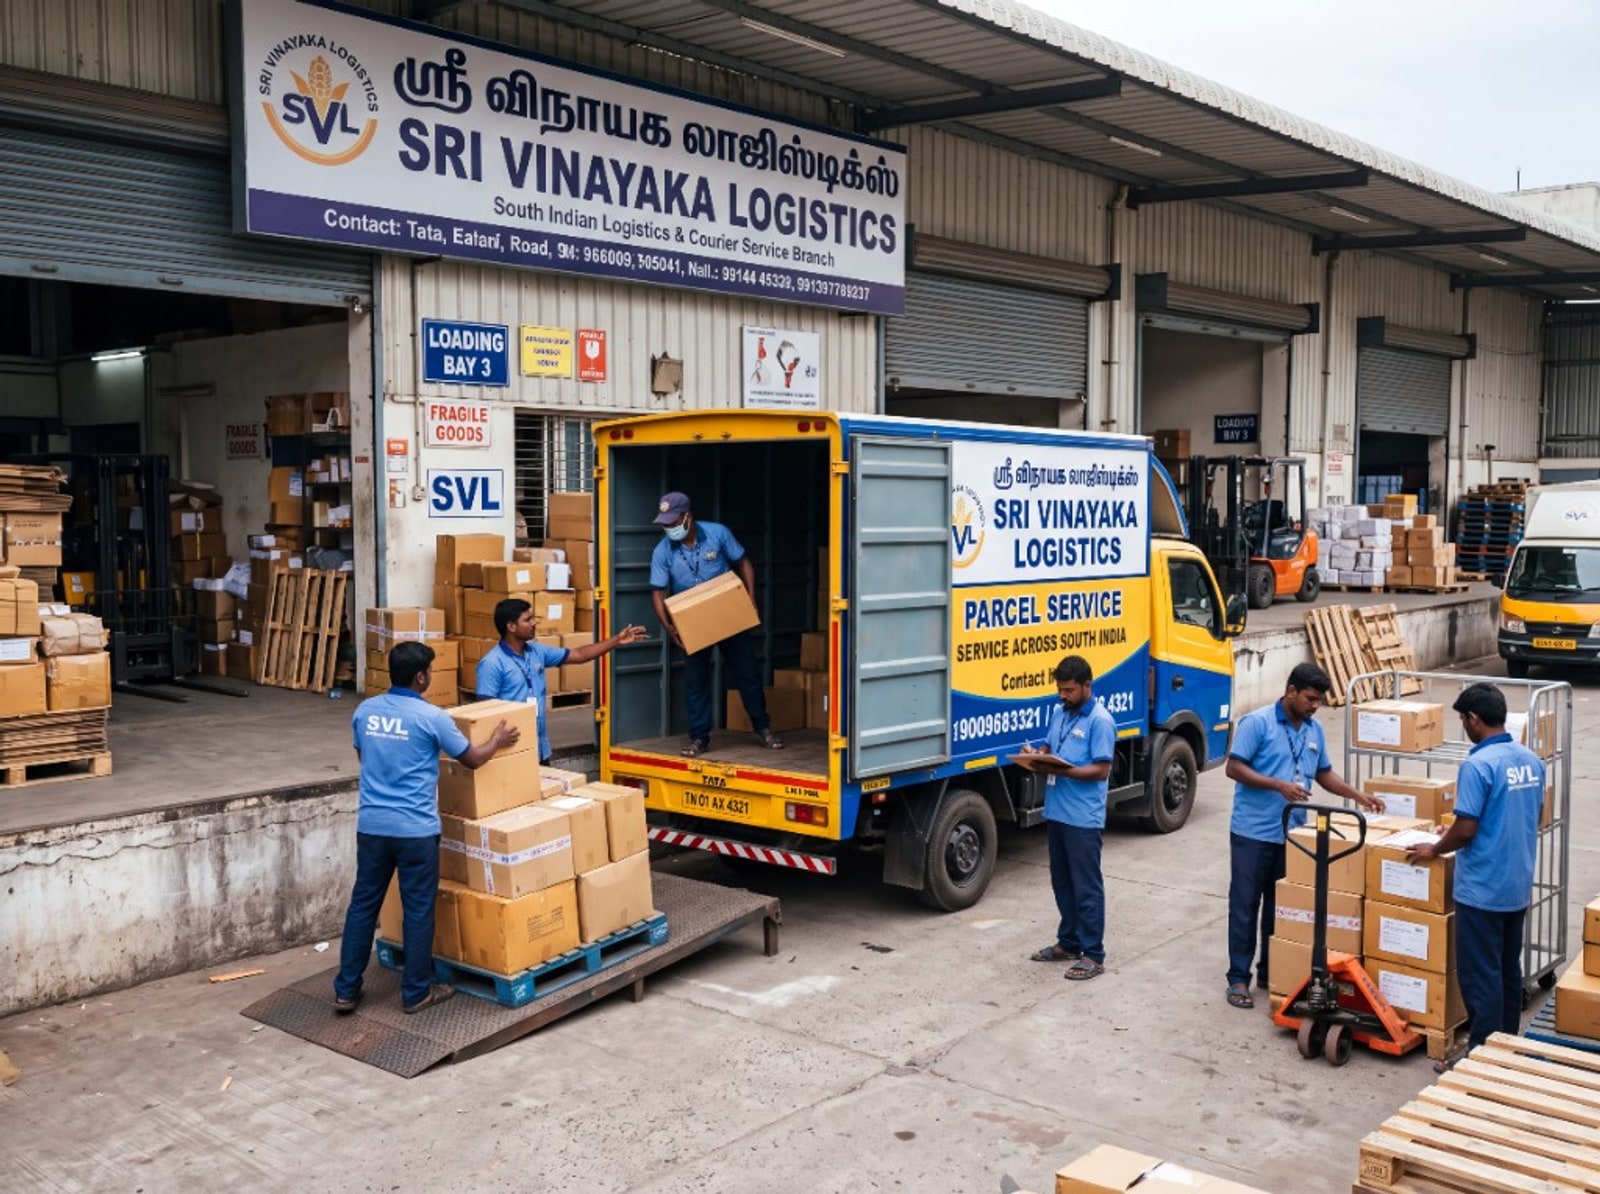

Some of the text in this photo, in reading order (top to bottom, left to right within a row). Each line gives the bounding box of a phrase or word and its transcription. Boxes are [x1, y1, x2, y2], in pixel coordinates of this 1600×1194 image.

[259, 34, 379, 112] SRI VINAYAKA LOGISTICS
[283, 93, 360, 144] SVL
[486, 69, 672, 148] விநாயக
[683, 122, 899, 198] லாஜிஸ்டிக்ஸ்
[398, 117, 896, 254] SRI VINAYAKA LOGISTICS
[323, 208, 401, 236] Contact:
[406, 220, 447, 245] Tata,
[510, 235, 552, 260] Road,
[493, 196, 835, 267] South Indian Logistics & Courier Service Branch
[429, 328, 504, 352] LOADING
[443, 356, 491, 377] BAY 3
[430, 405, 487, 423] FRAGILE
[435, 425, 483, 442] GOODS
[1223, 430, 1248, 440] BAY 3
[432, 475, 500, 512] SVL
[993, 499, 1029, 529] SRI
[1038, 500, 1138, 529] VINAYAKA
[951, 525, 977, 555] VL
[1014, 537, 1121, 568] LOGISTICS
[964, 591, 1122, 630] PARCEL SERVICE
[957, 627, 1126, 662] SERVICE ACROSS SOUTH INDIA
[1001, 668, 1045, 691] Contact
[366, 715, 409, 735] SVL
[702, 776, 726, 788] TATA
[1506, 765, 1539, 784] SVL
[712, 797, 725, 811] AX
[727, 799, 749, 816] 4321
